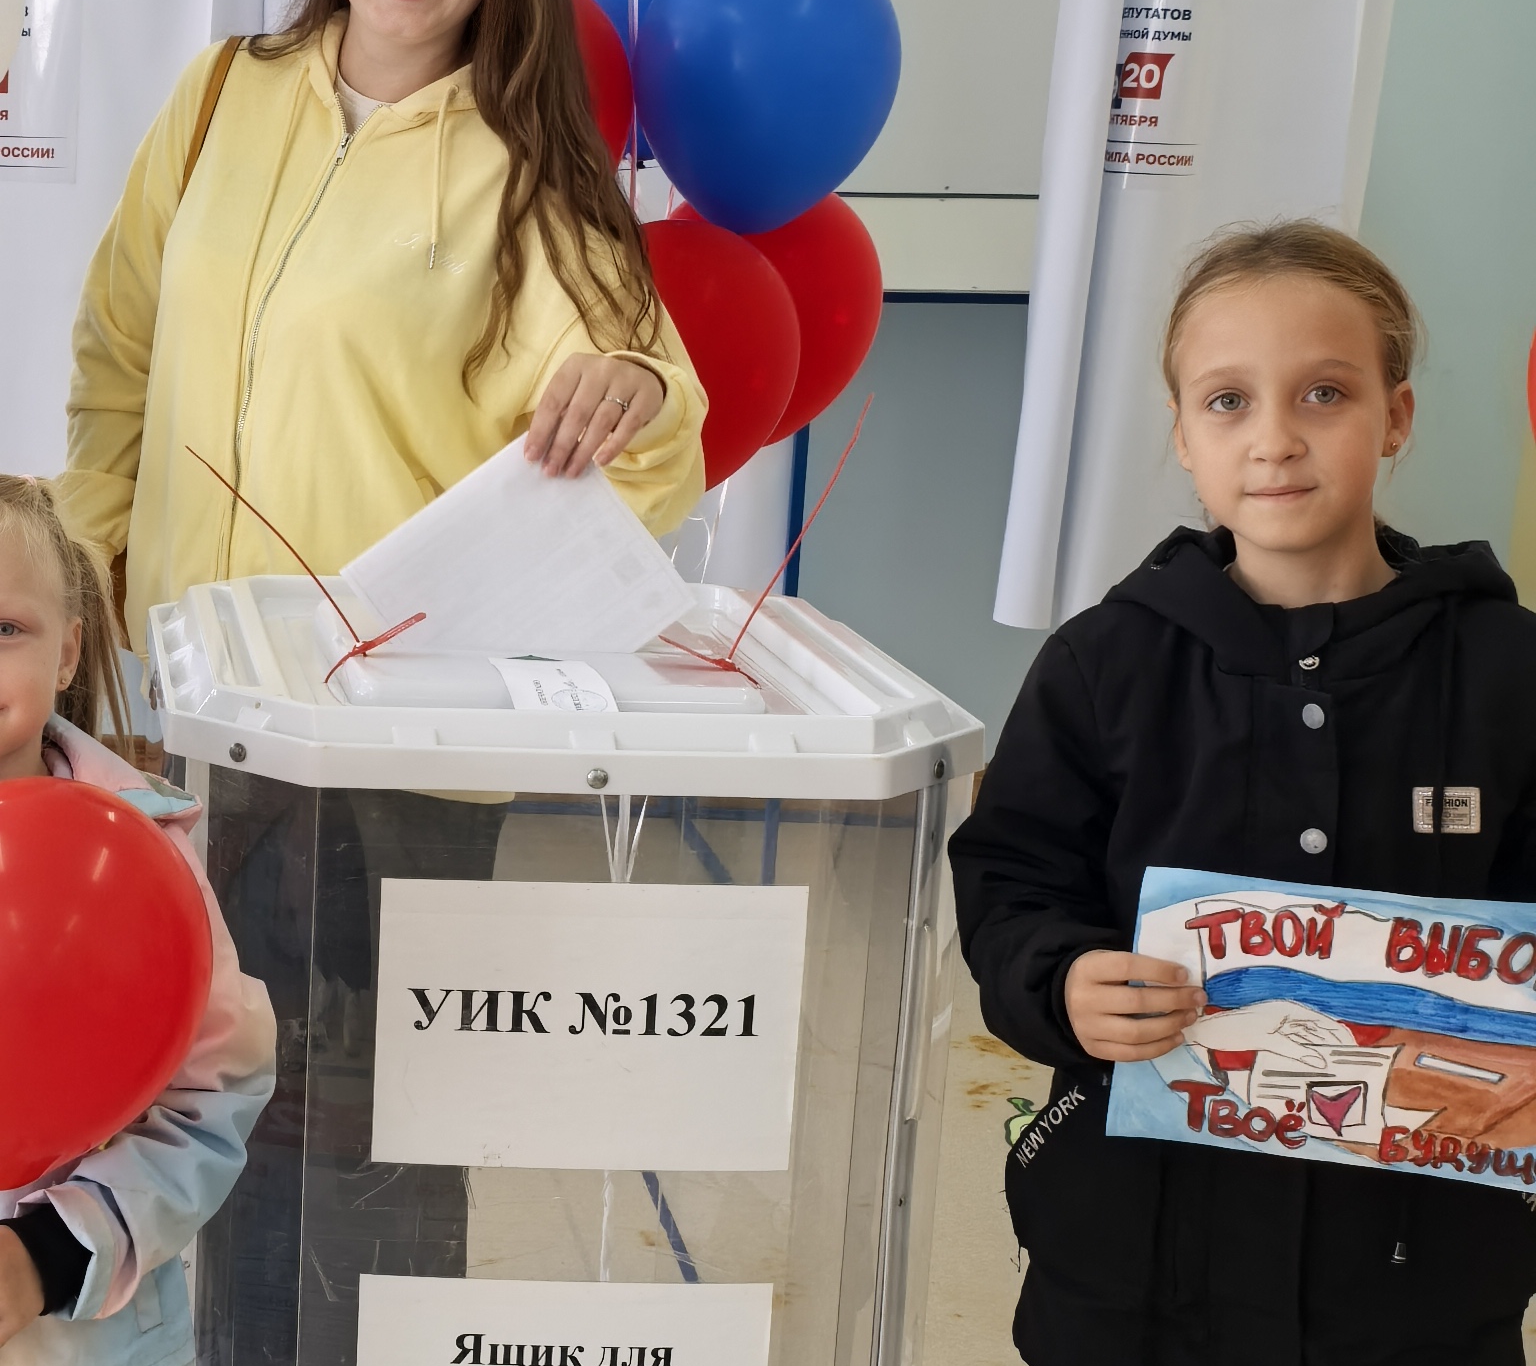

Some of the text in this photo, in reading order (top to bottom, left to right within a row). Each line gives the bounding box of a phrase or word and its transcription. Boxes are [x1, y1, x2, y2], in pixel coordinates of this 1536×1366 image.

[1122, 7, 1192, 21] ЕПУТАТОВ
[1152, 30, 1192, 42] ДУМЫ
[1122, 62, 1161, 89] 20
[1109, 114, 1159, 127] НТЯБРЯ
[1135, 153, 1194, 167] РОССИИ!
[1425, 798, 1469, 808] FHION
[1185, 900, 1536, 986] ТВОЙ ВЫБО
[406, 986, 759, 1038] УИК №1321
[1015, 1085, 1086, 1169] NEW YORK
